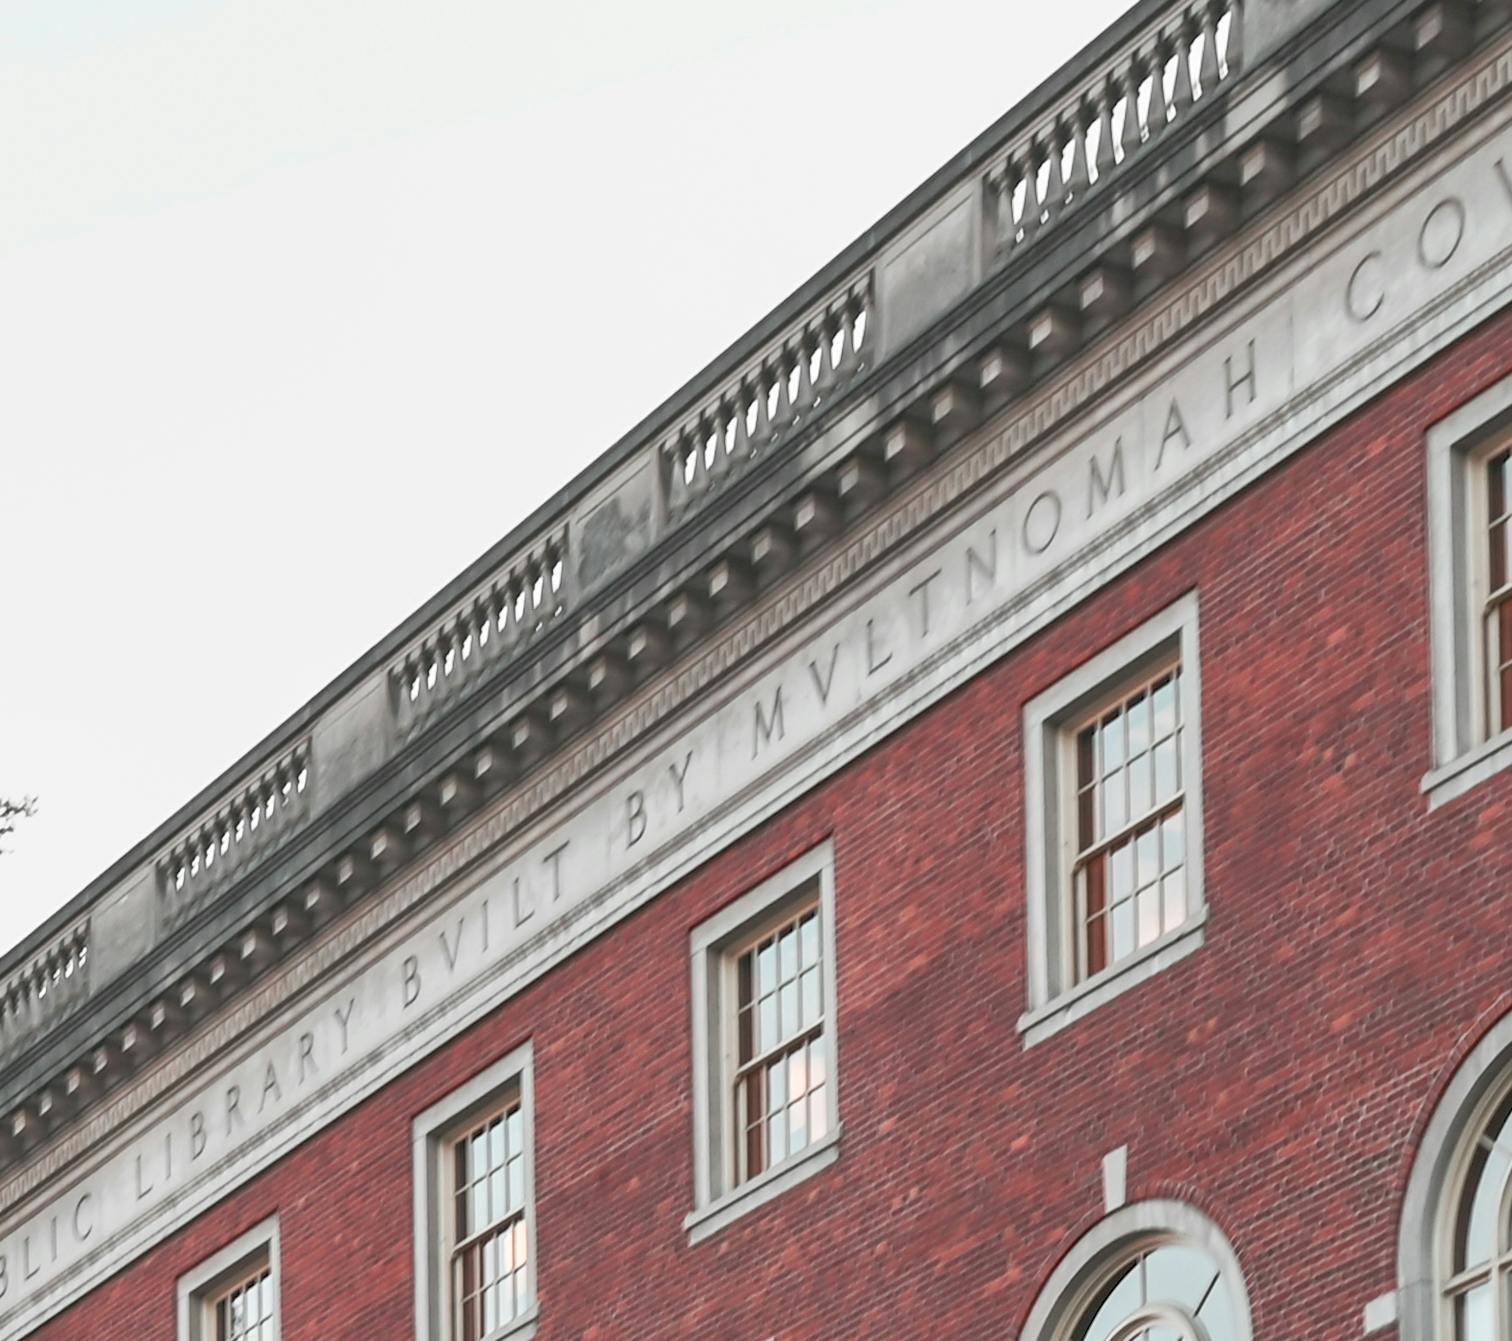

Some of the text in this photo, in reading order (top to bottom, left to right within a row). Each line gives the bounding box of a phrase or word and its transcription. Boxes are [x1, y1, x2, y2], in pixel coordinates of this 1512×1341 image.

[135, 997, 359, 1201] LIBRARY
[625, 749, 694, 850] BY
[751, 337, 1258, 760] MVLTNOMAH
